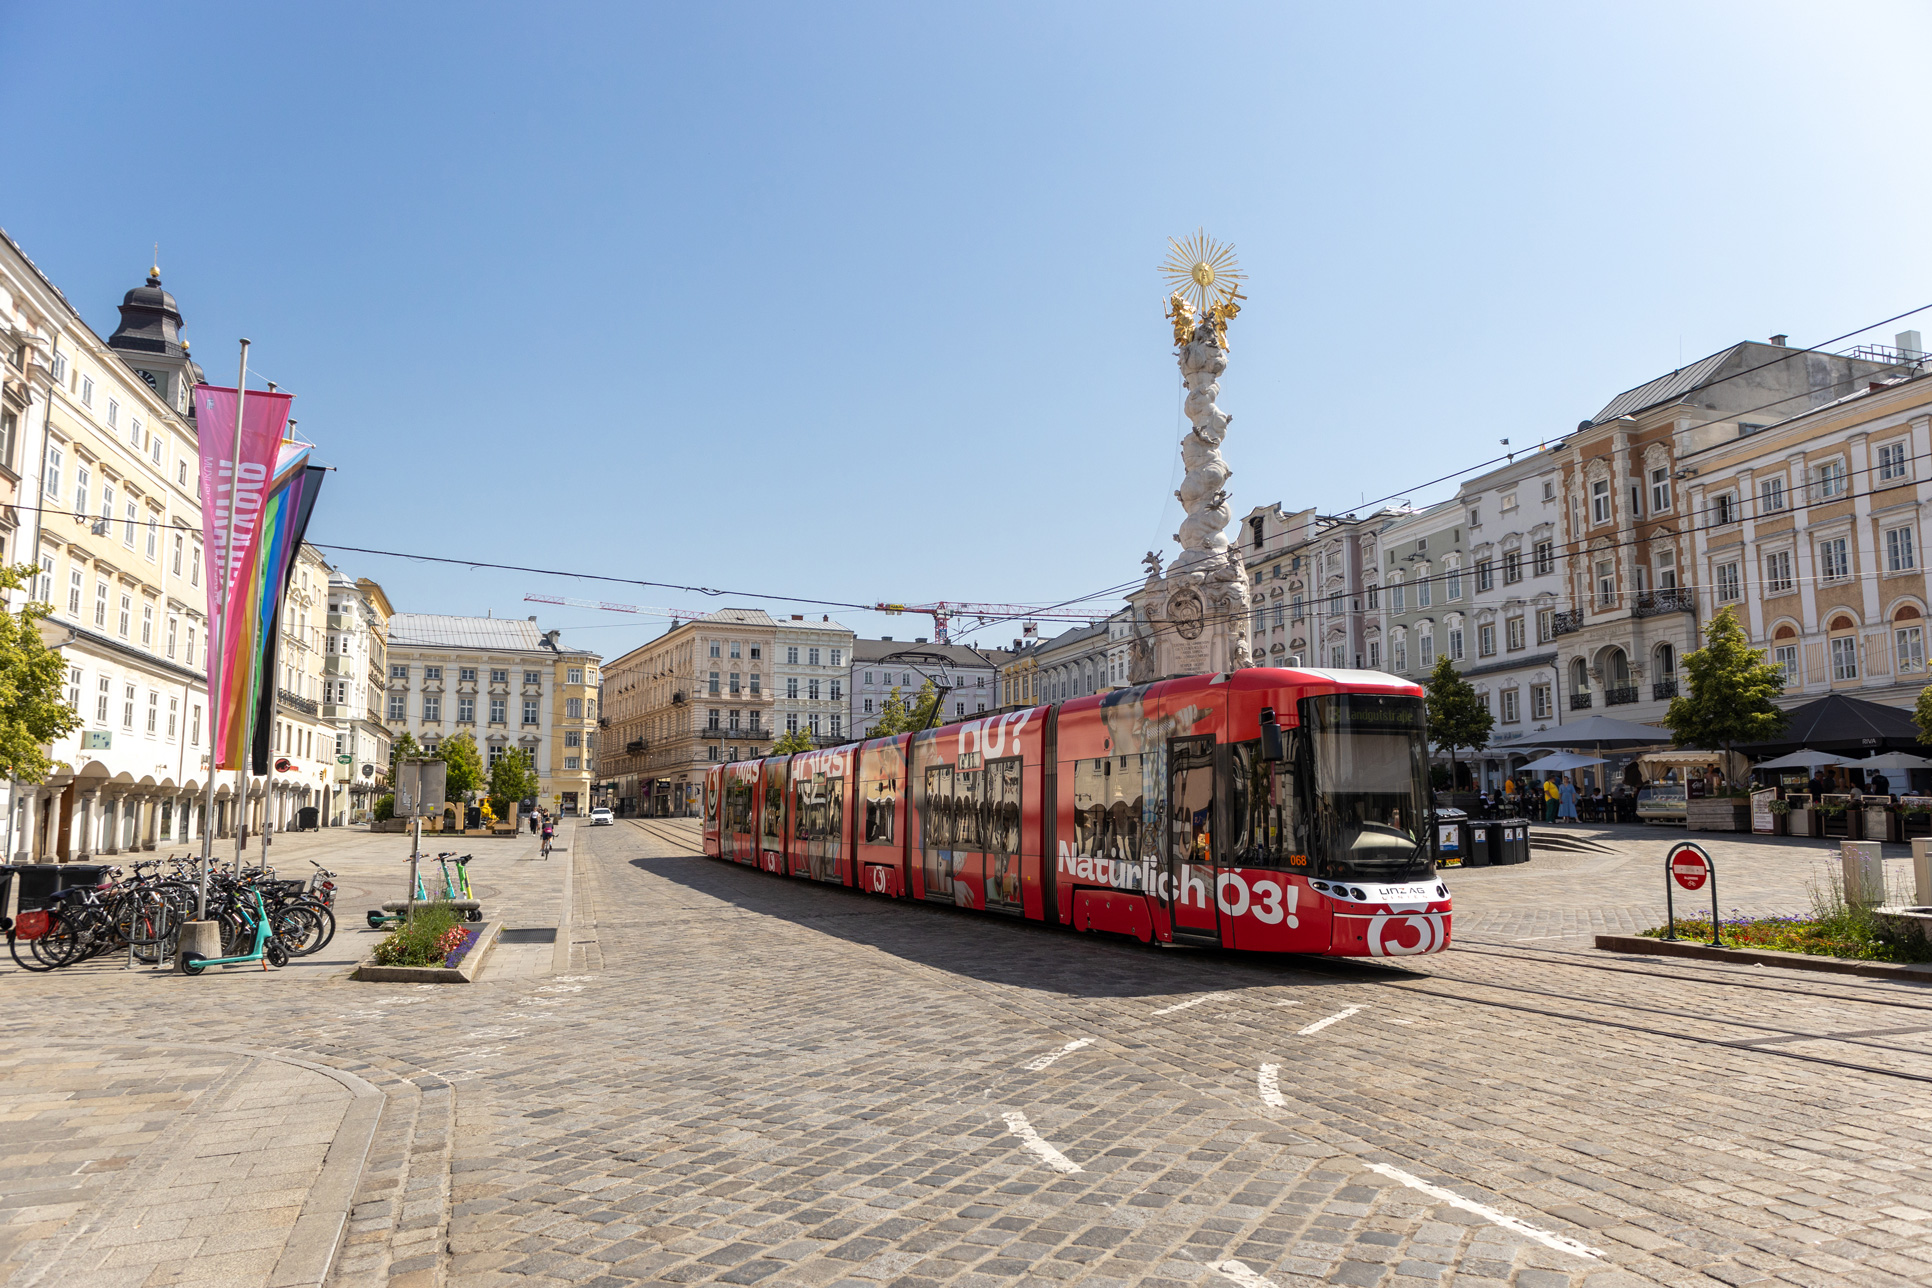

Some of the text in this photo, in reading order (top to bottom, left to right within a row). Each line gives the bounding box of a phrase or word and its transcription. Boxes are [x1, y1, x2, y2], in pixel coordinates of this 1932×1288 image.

[1346, 709, 1414, 724] Landgutstraße
[736, 758, 762, 785] WAS
[1290, 855, 1307, 866] 068
[1058, 840, 1299, 929] Natürlich Ö3!
